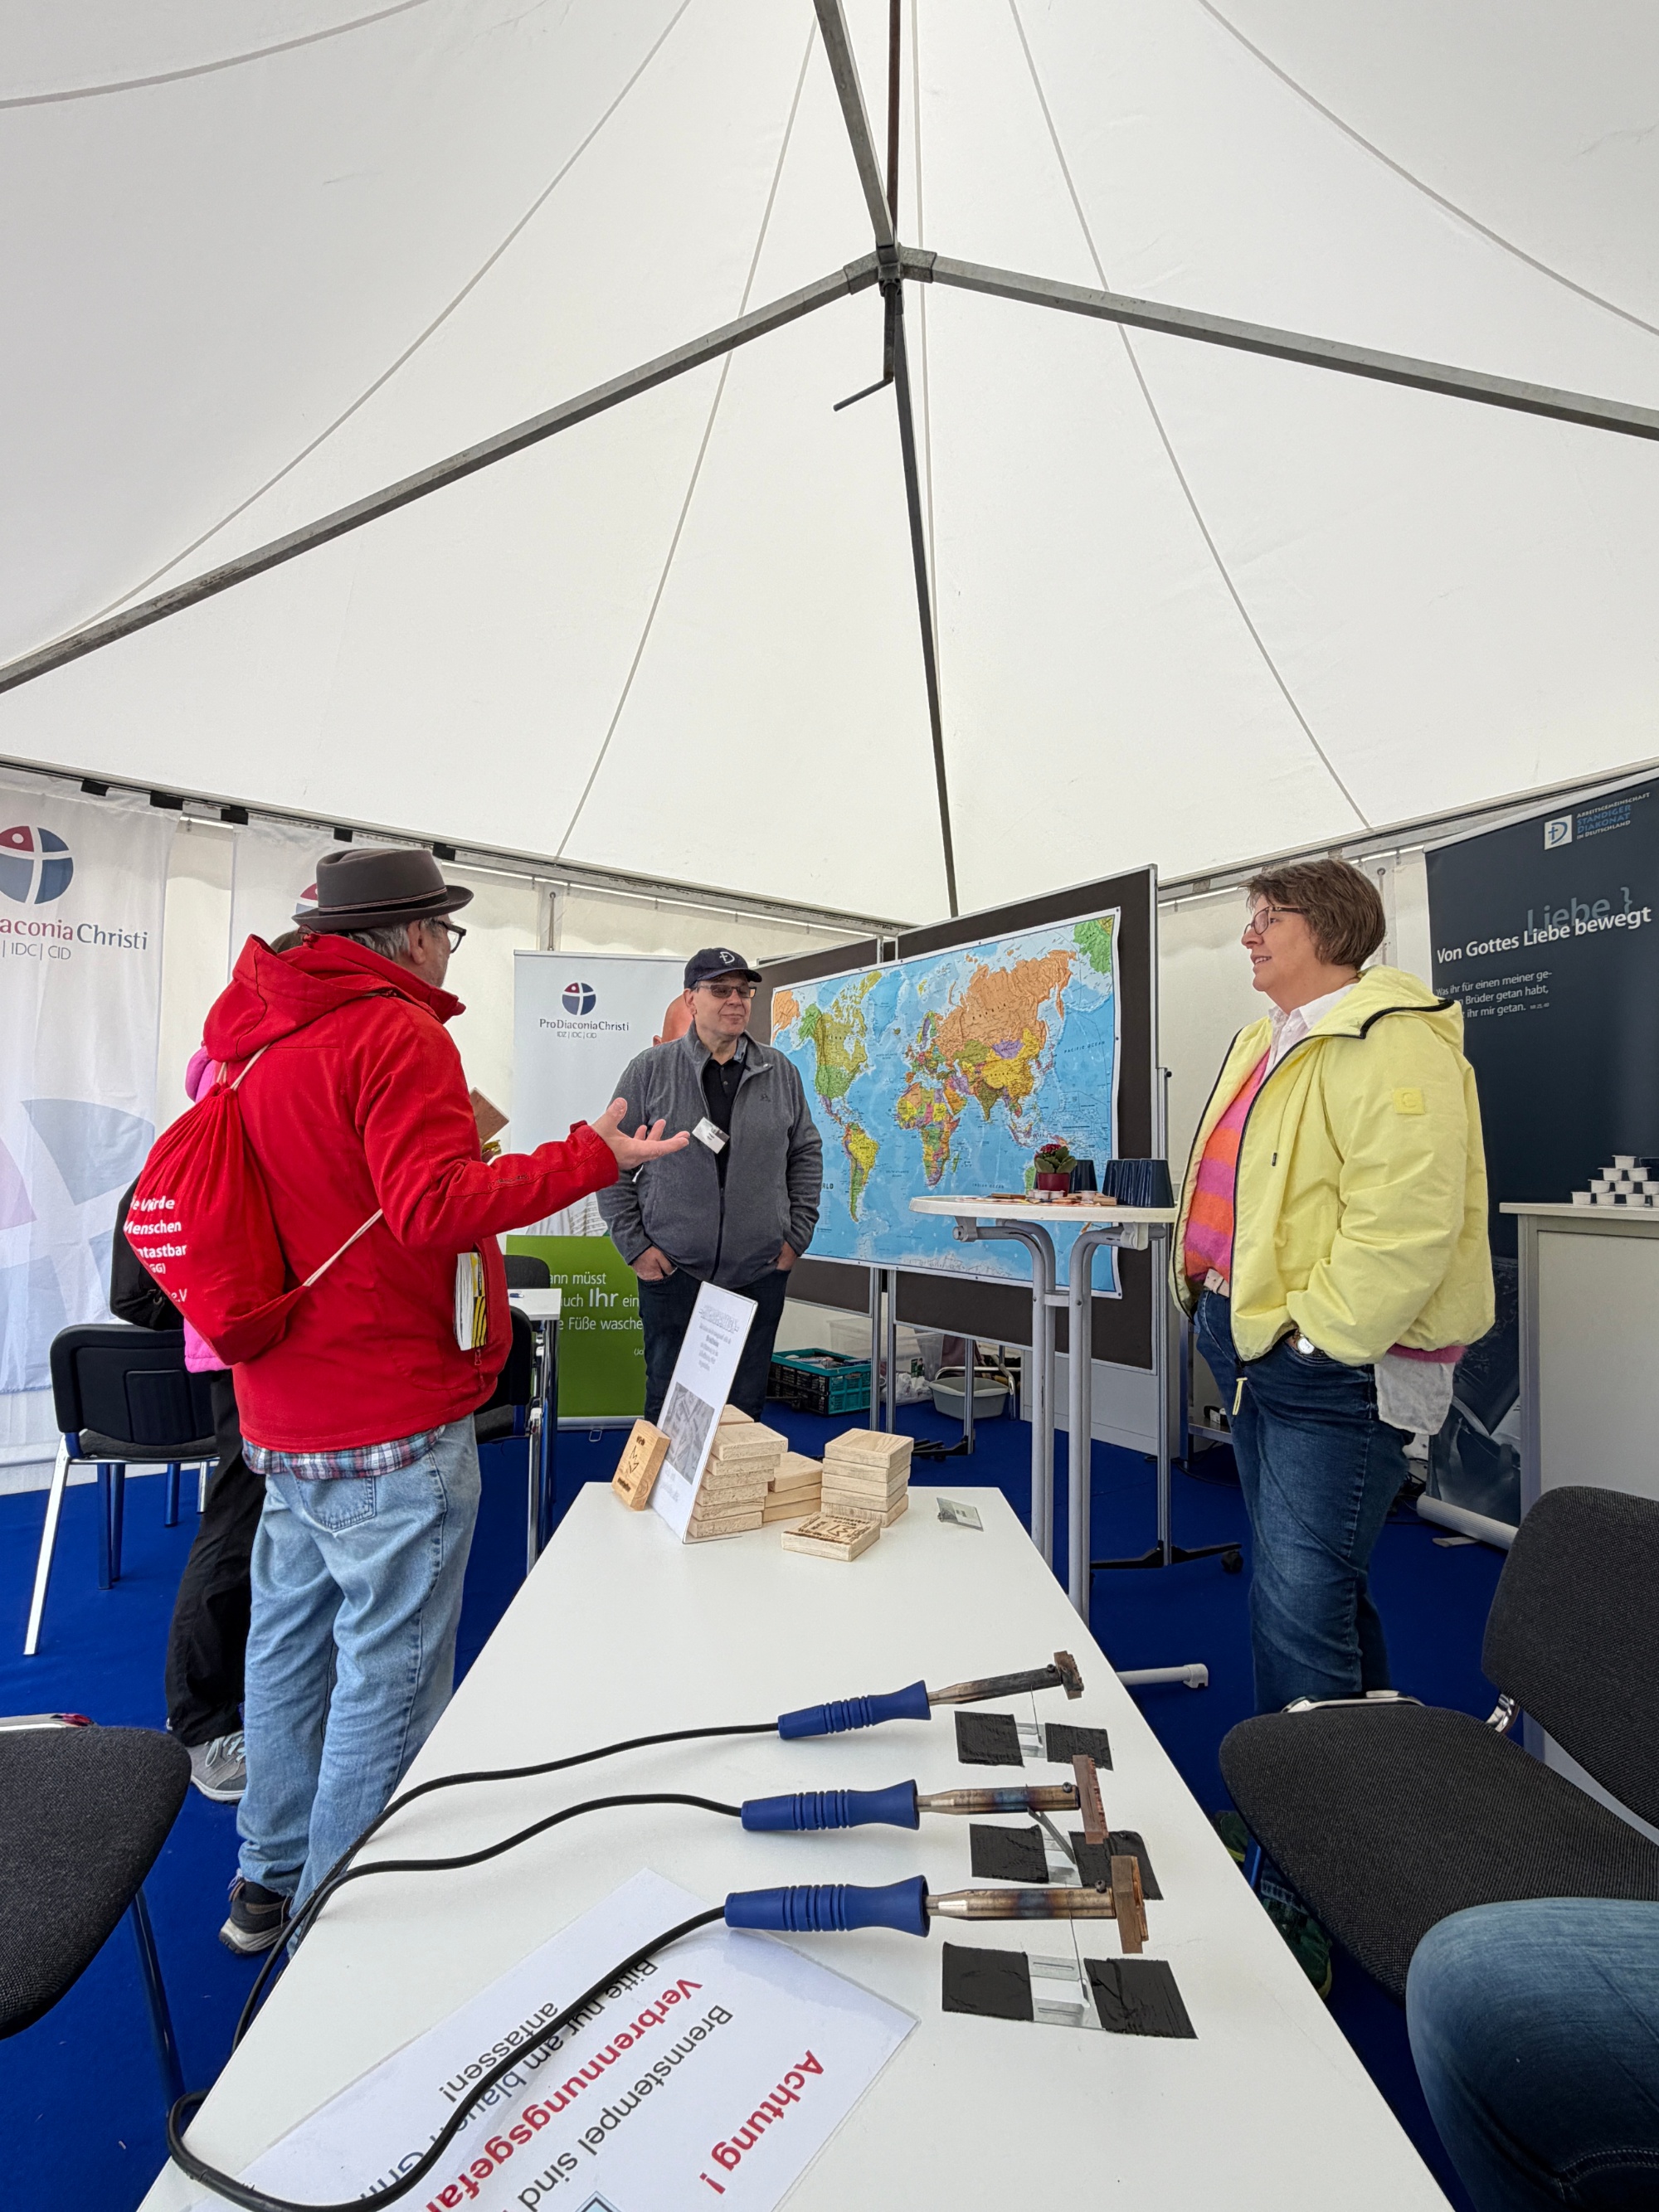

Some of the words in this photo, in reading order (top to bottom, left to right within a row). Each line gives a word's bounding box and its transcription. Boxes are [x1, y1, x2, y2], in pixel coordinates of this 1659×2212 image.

[1577, 813, 1631, 834] DIAKONAT
[1526, 897, 1611, 936] Liebe
[1437, 946, 1462, 964] Von
[1466, 936, 1520, 957] Gottes
[1523, 924, 1570, 947] Liebe
[1575, 906, 1652, 936] bewegt
[47, 945, 72, 960] CID
[1436, 987, 1449, 997] Was
[1449, 984, 1461, 994] ihr
[1462, 981, 1474, 991] für
[1475, 979, 1501, 989] einen
[1501, 974, 1535, 986] meiner
[1536, 971, 1553, 982] ge-
[1465, 993, 1495, 1005] Brüder
[1496, 989, 1523, 1003] getan
[1525, 984, 1549, 997] habt,
[1467, 1008, 1479, 1018] ihr
[1480, 1004, 1495, 1016] mir
[1496, 1003, 1526, 1017] getan.
[572, 1271, 606, 1285] müsst
[561, 1293, 584, 1307] uch
[589, 1287, 619, 1307] Ihr
[568, 1316, 596, 1330] Füße
[601, 1317, 644, 1330] wasche
[605, 1959, 659, 1999] Bitte
[565, 2000, 606, 2036] nur
[523, 2035, 564, 2070] am
[577, 2004, 733, 2156] Brennstempel
[711, 2049, 825, 2171] Achtung
[517, 2152, 578, 2212] sind
